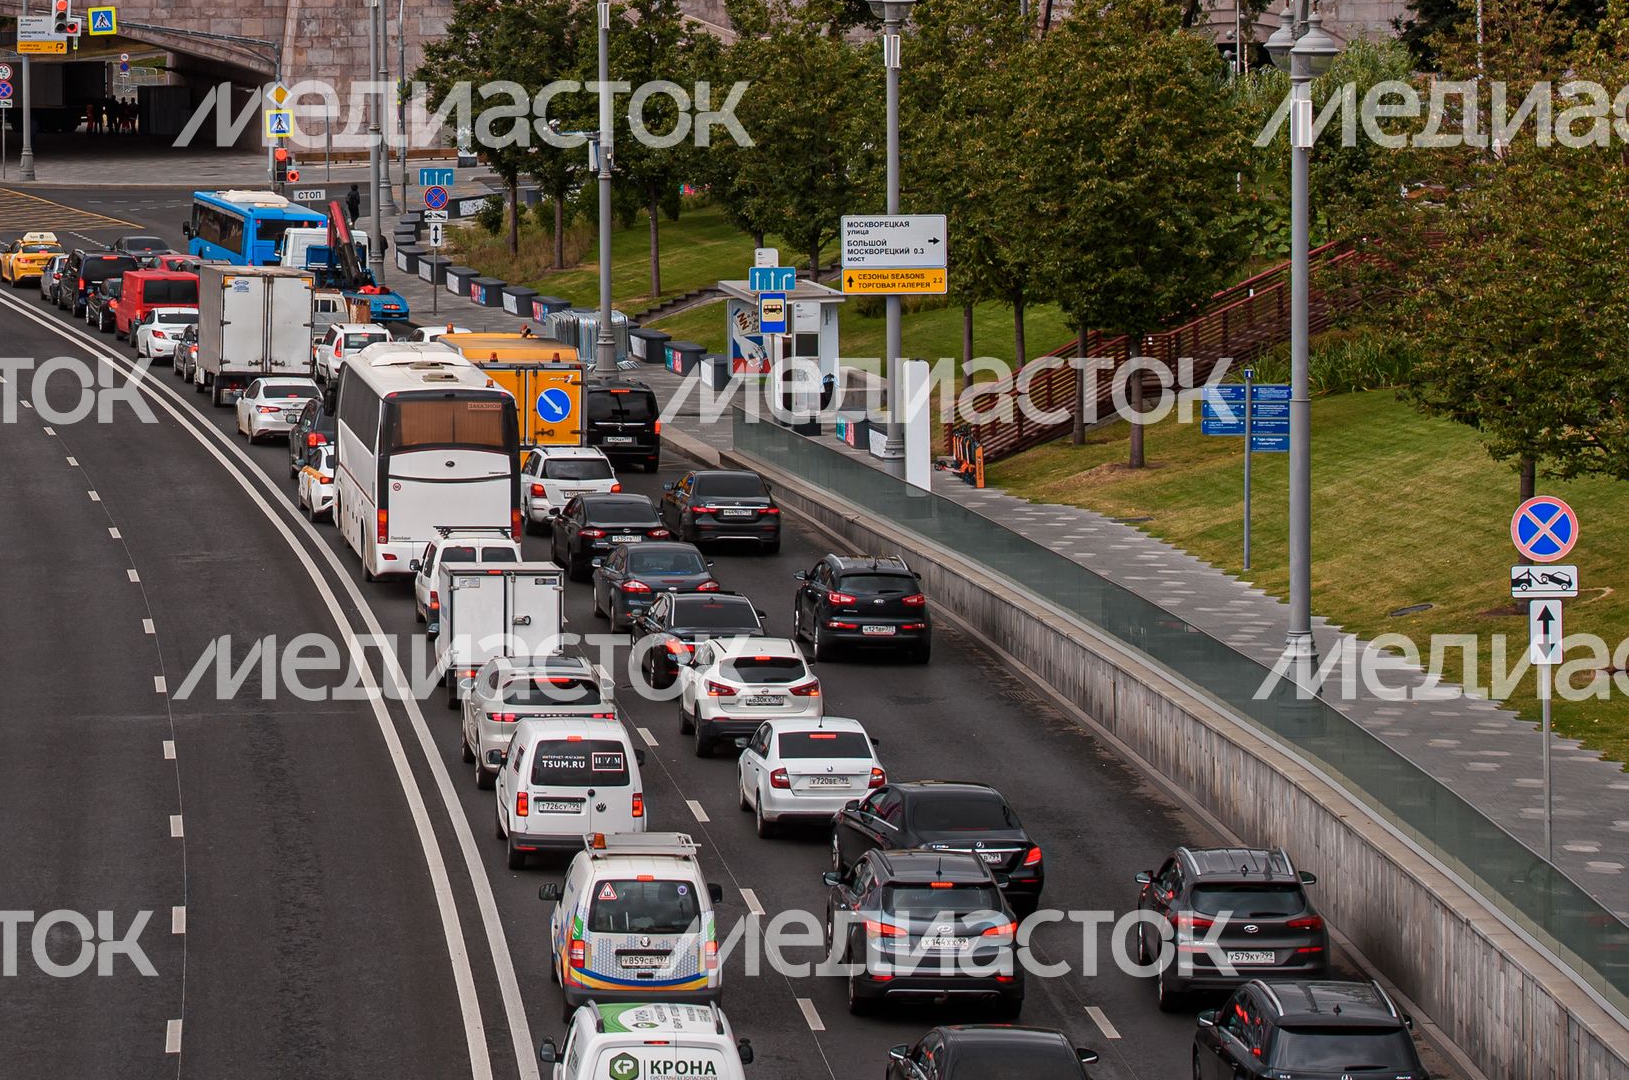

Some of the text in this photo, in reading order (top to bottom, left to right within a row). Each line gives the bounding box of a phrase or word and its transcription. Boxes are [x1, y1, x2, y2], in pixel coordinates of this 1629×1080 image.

[298, 190, 322, 200] СТОП
[847, 238, 887, 247] БОЛЬШОЙ
[847, 247, 910, 255] МОСКВОРЕЦКИЙ
[542, 760, 586, 768] TSUM.RU
[650, 1060, 717, 1076] КРОНА
